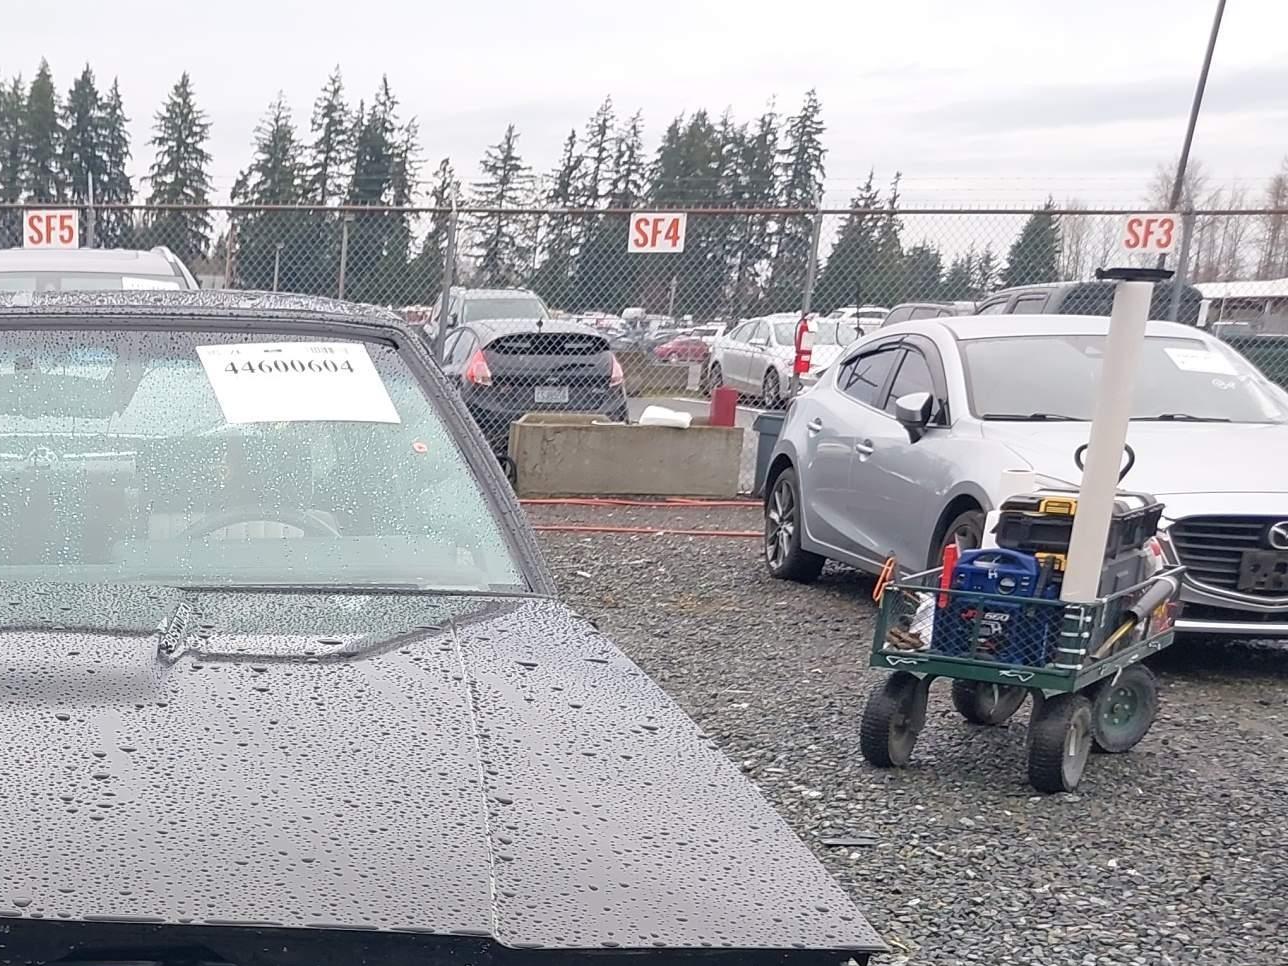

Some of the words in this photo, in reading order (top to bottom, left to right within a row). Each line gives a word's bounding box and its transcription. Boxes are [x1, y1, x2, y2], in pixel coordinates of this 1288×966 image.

[28, 215, 75, 244] SF5
[633, 218, 682, 249] SF4
[1124, 220, 1175, 250] SF3
[224, 360, 354, 374] 44600604
[984, 612, 1010, 621] 660
